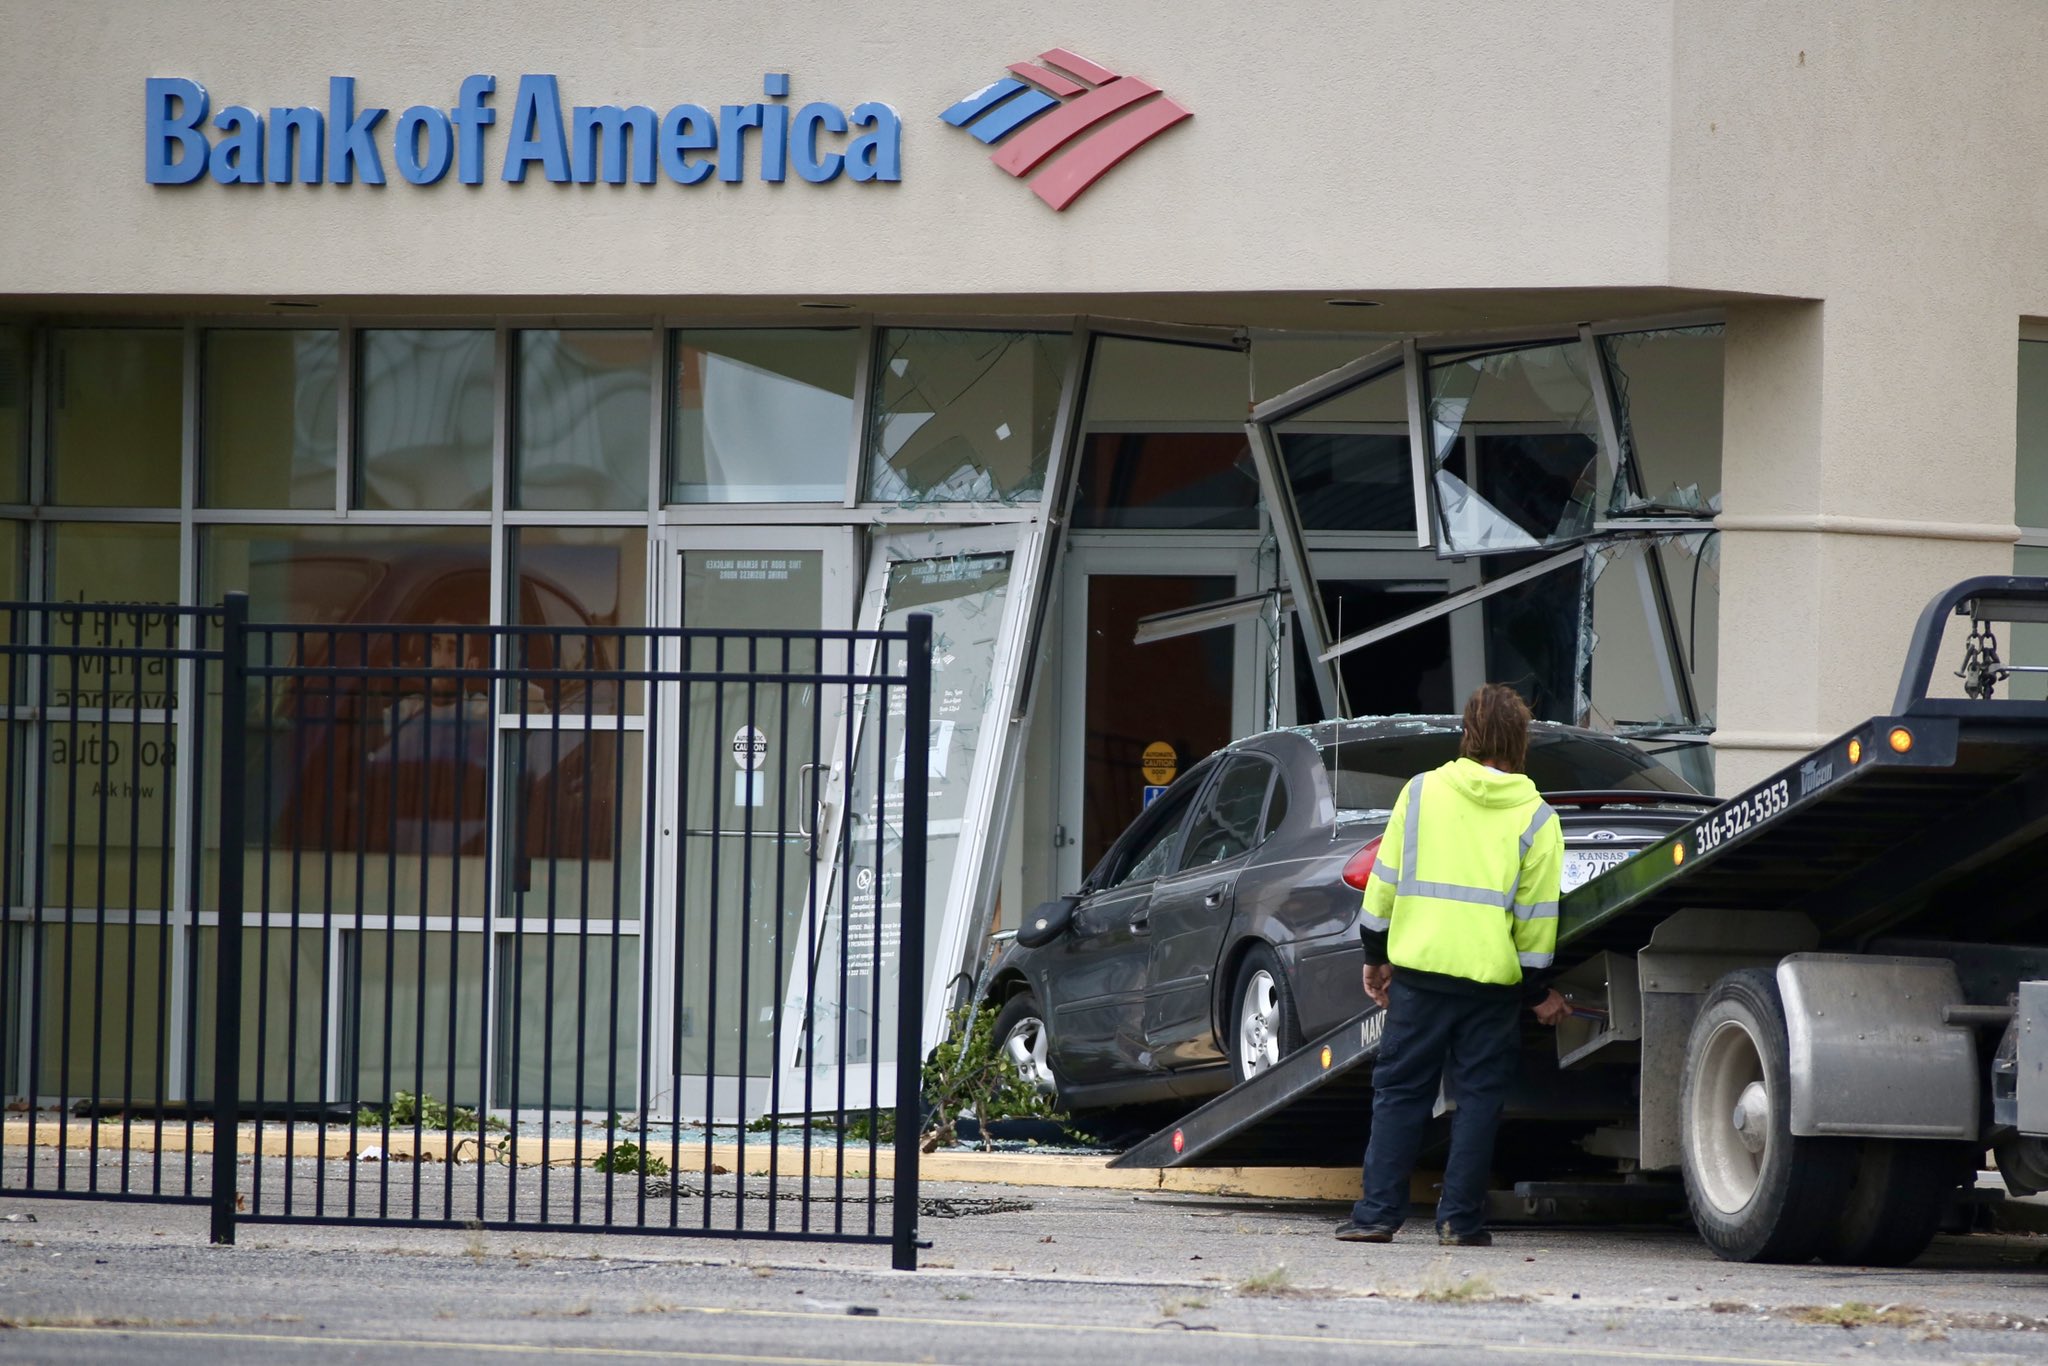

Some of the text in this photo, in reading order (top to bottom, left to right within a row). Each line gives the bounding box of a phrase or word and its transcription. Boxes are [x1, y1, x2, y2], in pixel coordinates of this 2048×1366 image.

[145, 73, 901, 186] Bank of America
[52, 733, 119, 766] auto
[734, 743, 765, 752] CAUON
[1696, 779, 1789, 855] 316-522-5353
[1578, 852, 1624, 860] KANSAS
